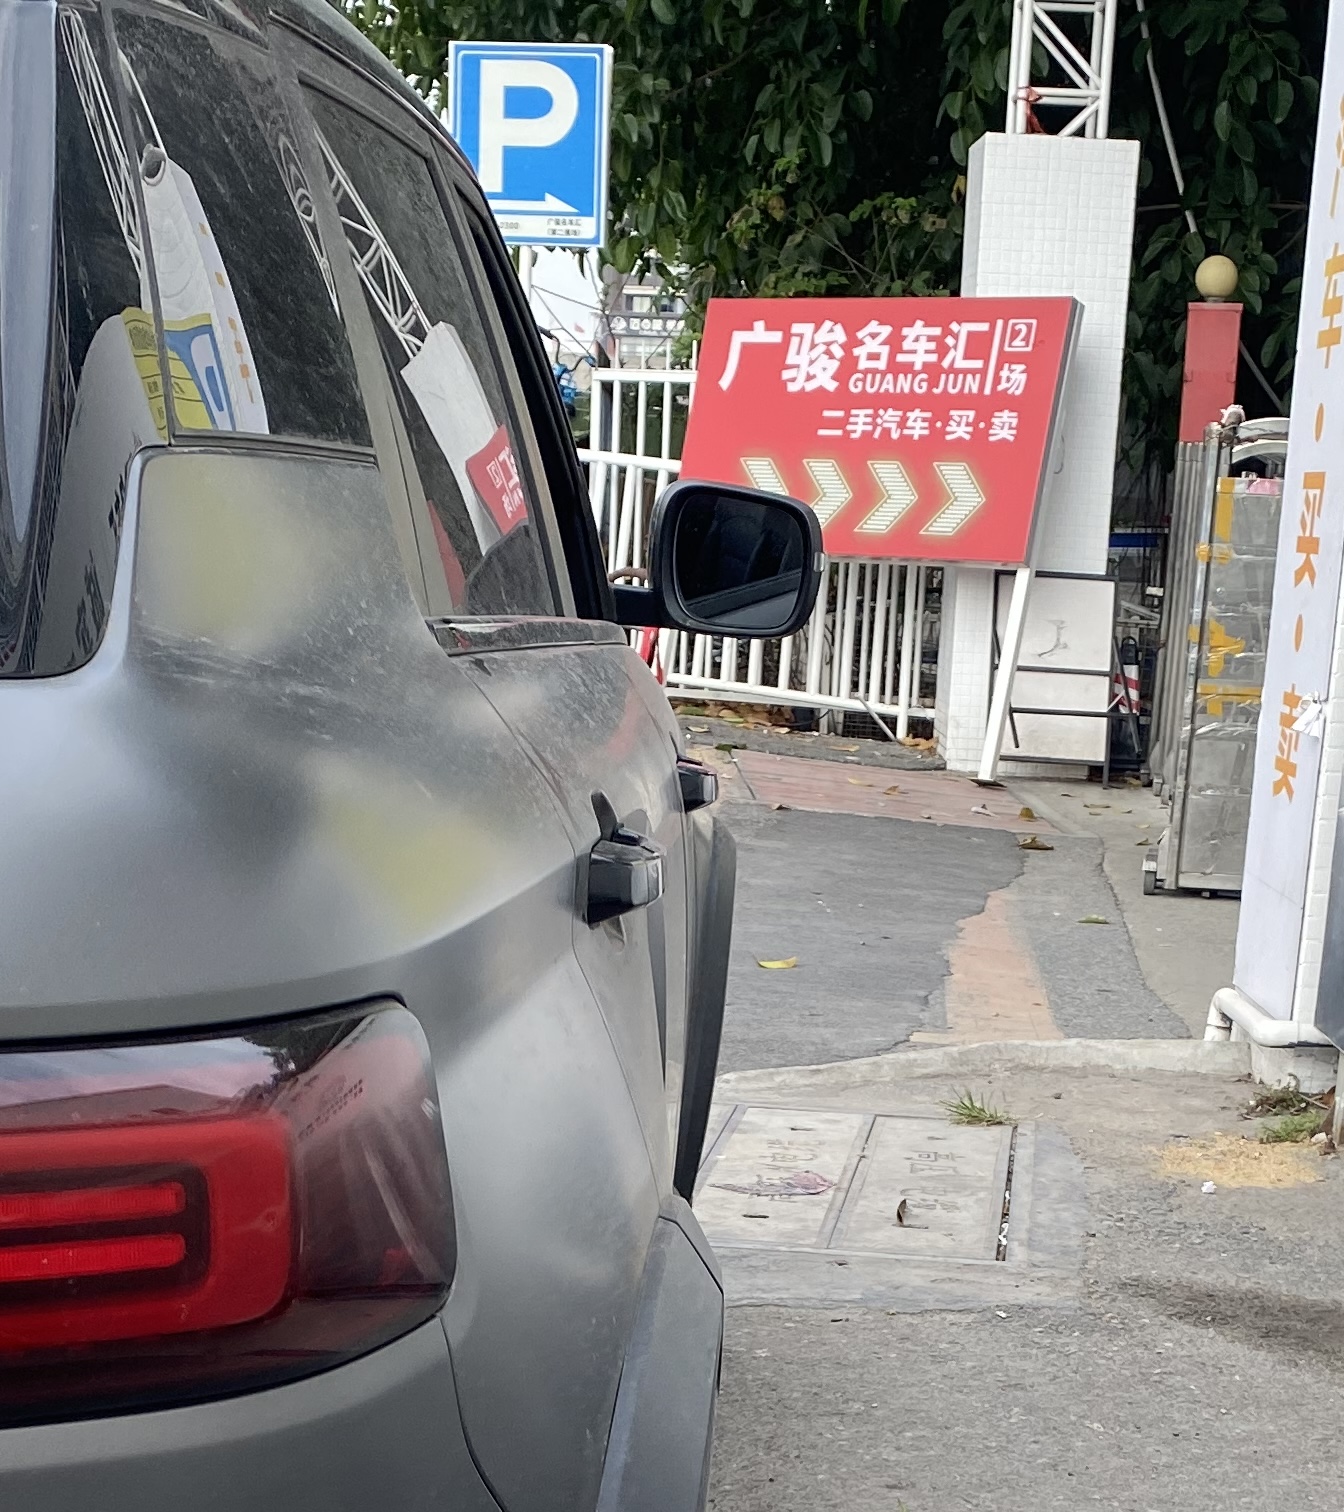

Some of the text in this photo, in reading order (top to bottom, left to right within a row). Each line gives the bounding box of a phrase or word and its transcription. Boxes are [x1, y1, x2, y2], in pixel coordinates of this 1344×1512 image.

[479, 59, 579, 192] P
[1009, 322, 1027, 347] 2
[718, 319, 990, 393] 广骏名车汇
[848, 373, 981, 394] GUANG JUN
[997, 363, 1027, 395] 场
